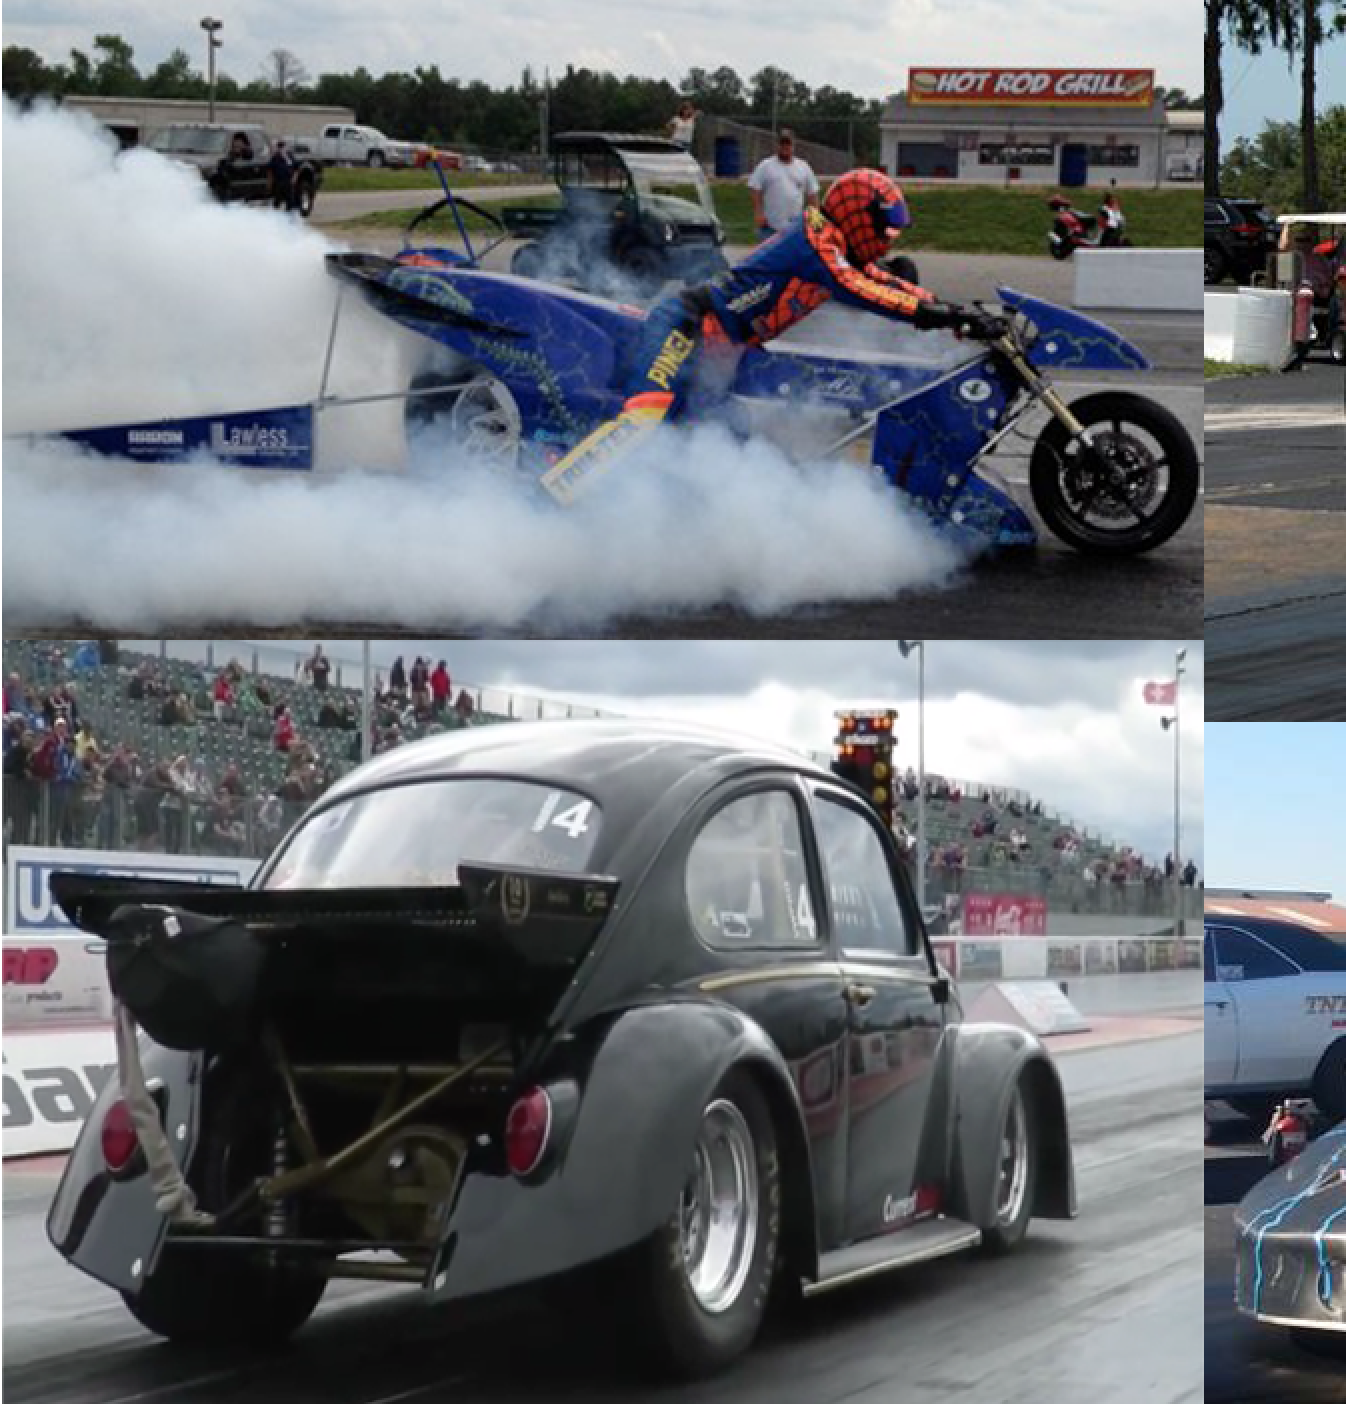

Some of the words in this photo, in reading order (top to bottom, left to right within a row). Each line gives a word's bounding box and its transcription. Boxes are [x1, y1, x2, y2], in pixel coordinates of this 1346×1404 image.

[936, 71, 992, 93] HOT
[994, 71, 1051, 94] ROD
[1054, 72, 1125, 95] GRILL
[210, 422, 288, 452] Lawless
[531, 790, 592, 838] 14
